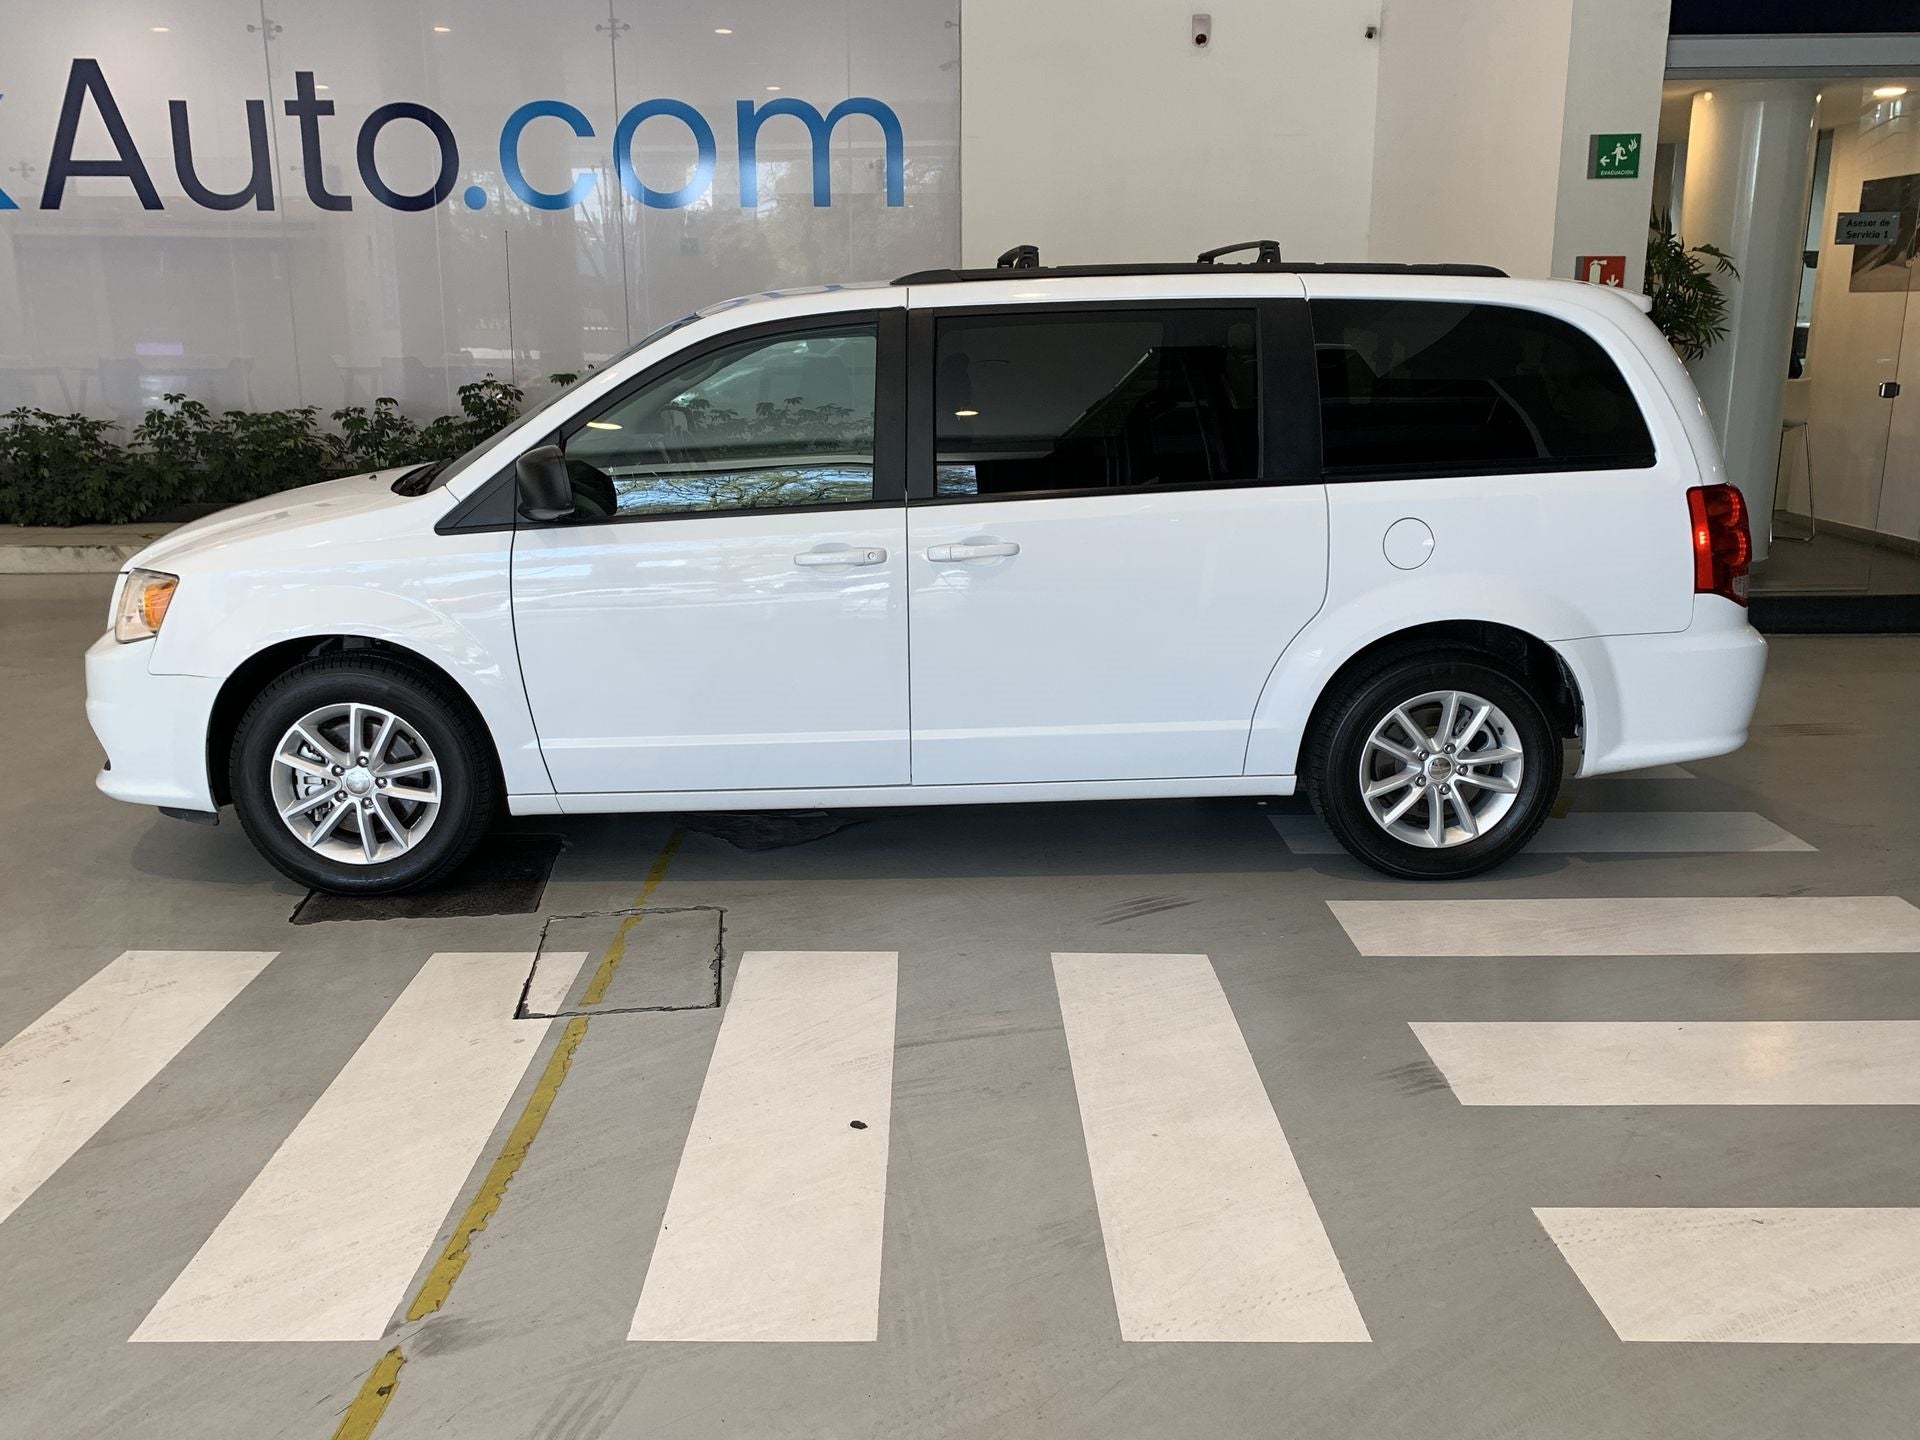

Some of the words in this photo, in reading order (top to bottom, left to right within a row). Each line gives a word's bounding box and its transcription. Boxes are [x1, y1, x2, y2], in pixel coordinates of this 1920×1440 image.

[1846, 218, 1877, 228] Asesor
[1879, 218, 1891, 227] de
[1846, 230, 1881, 239] Servicio
[1883, 230, 1889, 239] 1
